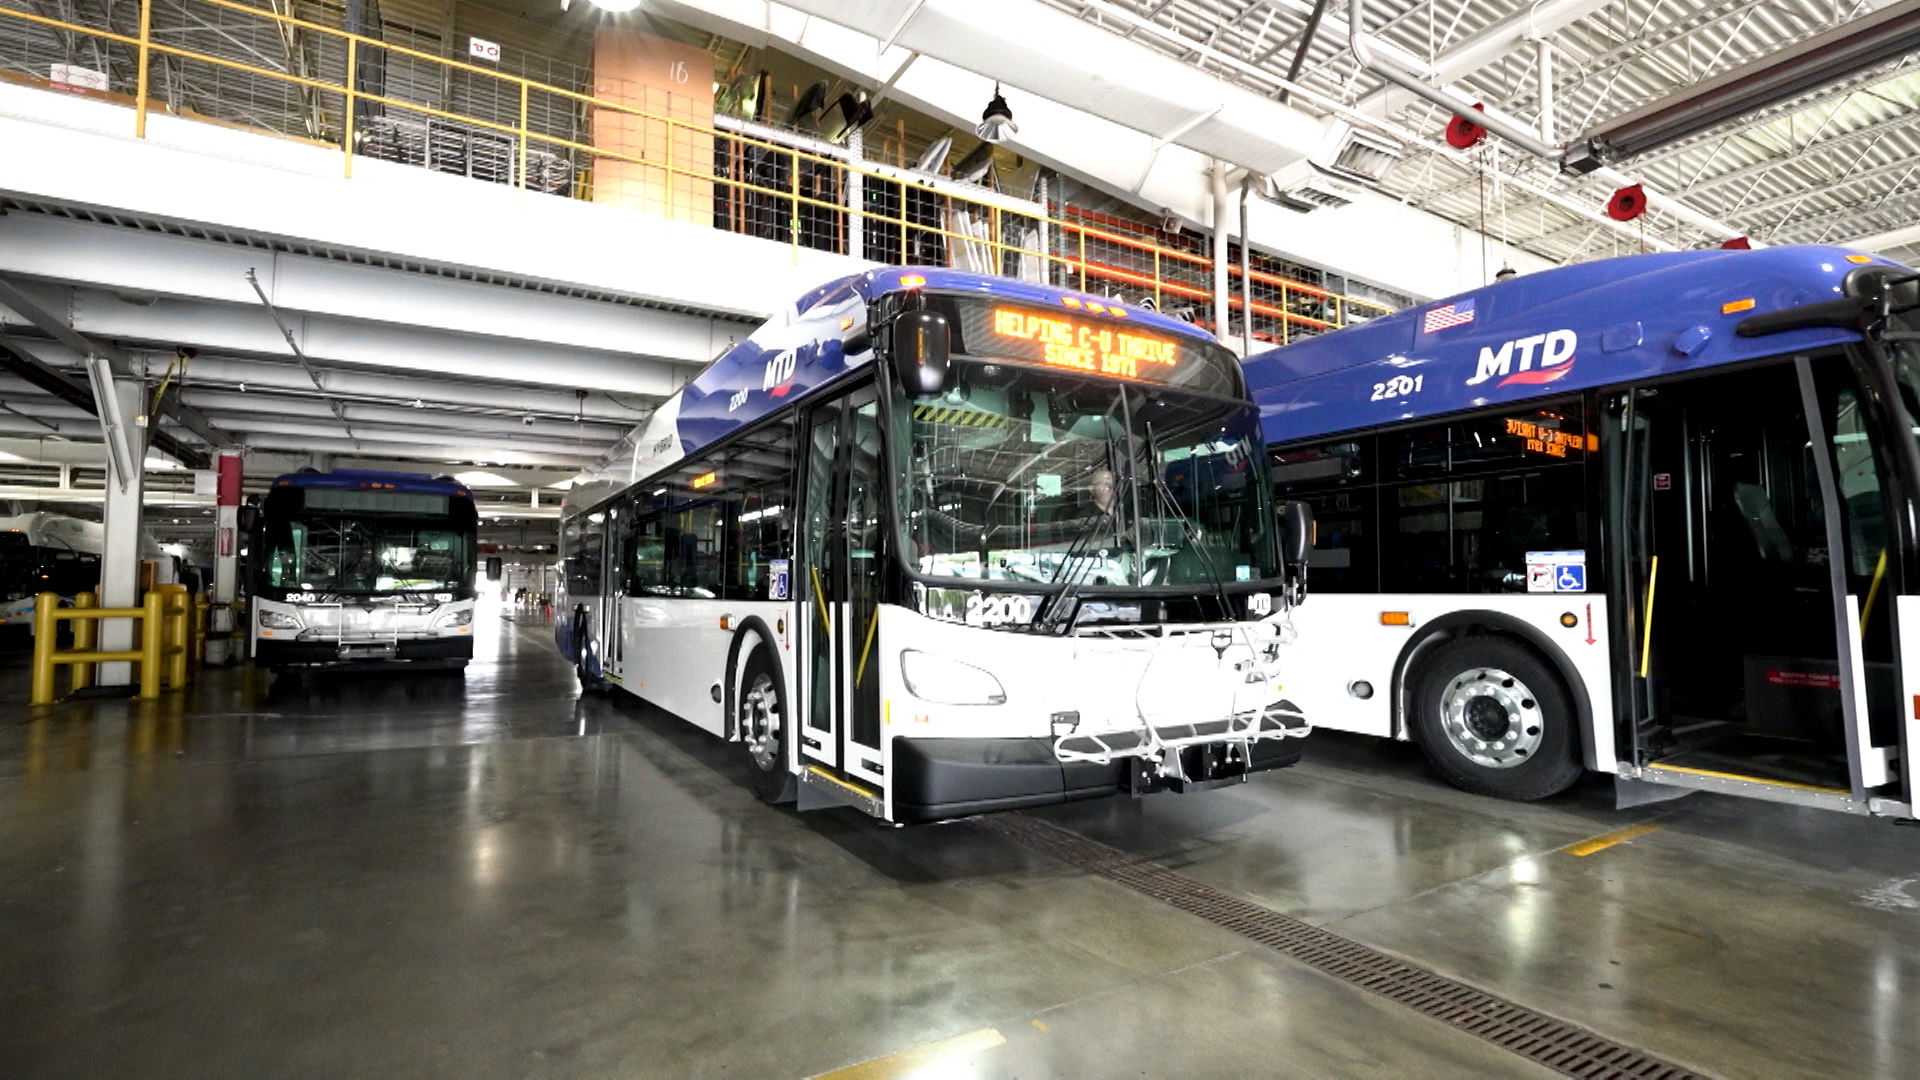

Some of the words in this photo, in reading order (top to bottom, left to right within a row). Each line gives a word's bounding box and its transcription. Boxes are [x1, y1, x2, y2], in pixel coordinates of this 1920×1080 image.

[669, 61, 689, 84] 16
[994, 309, 1073, 346] HELPING
[1078, 326, 1112, 353] C-U
[1117, 333, 1177, 365] THRIVE
[763, 347, 797, 392] MTD
[1044, 343, 1096, 370] SINCE
[1101, 353, 1137, 377] 1971
[1465, 328, 1578, 386] MTD
[729, 387, 749, 412] 2200
[1370, 373, 1424, 402] 2201
[965, 594, 1031, 627] 2200
[1247, 592, 1271, 613] MTD
